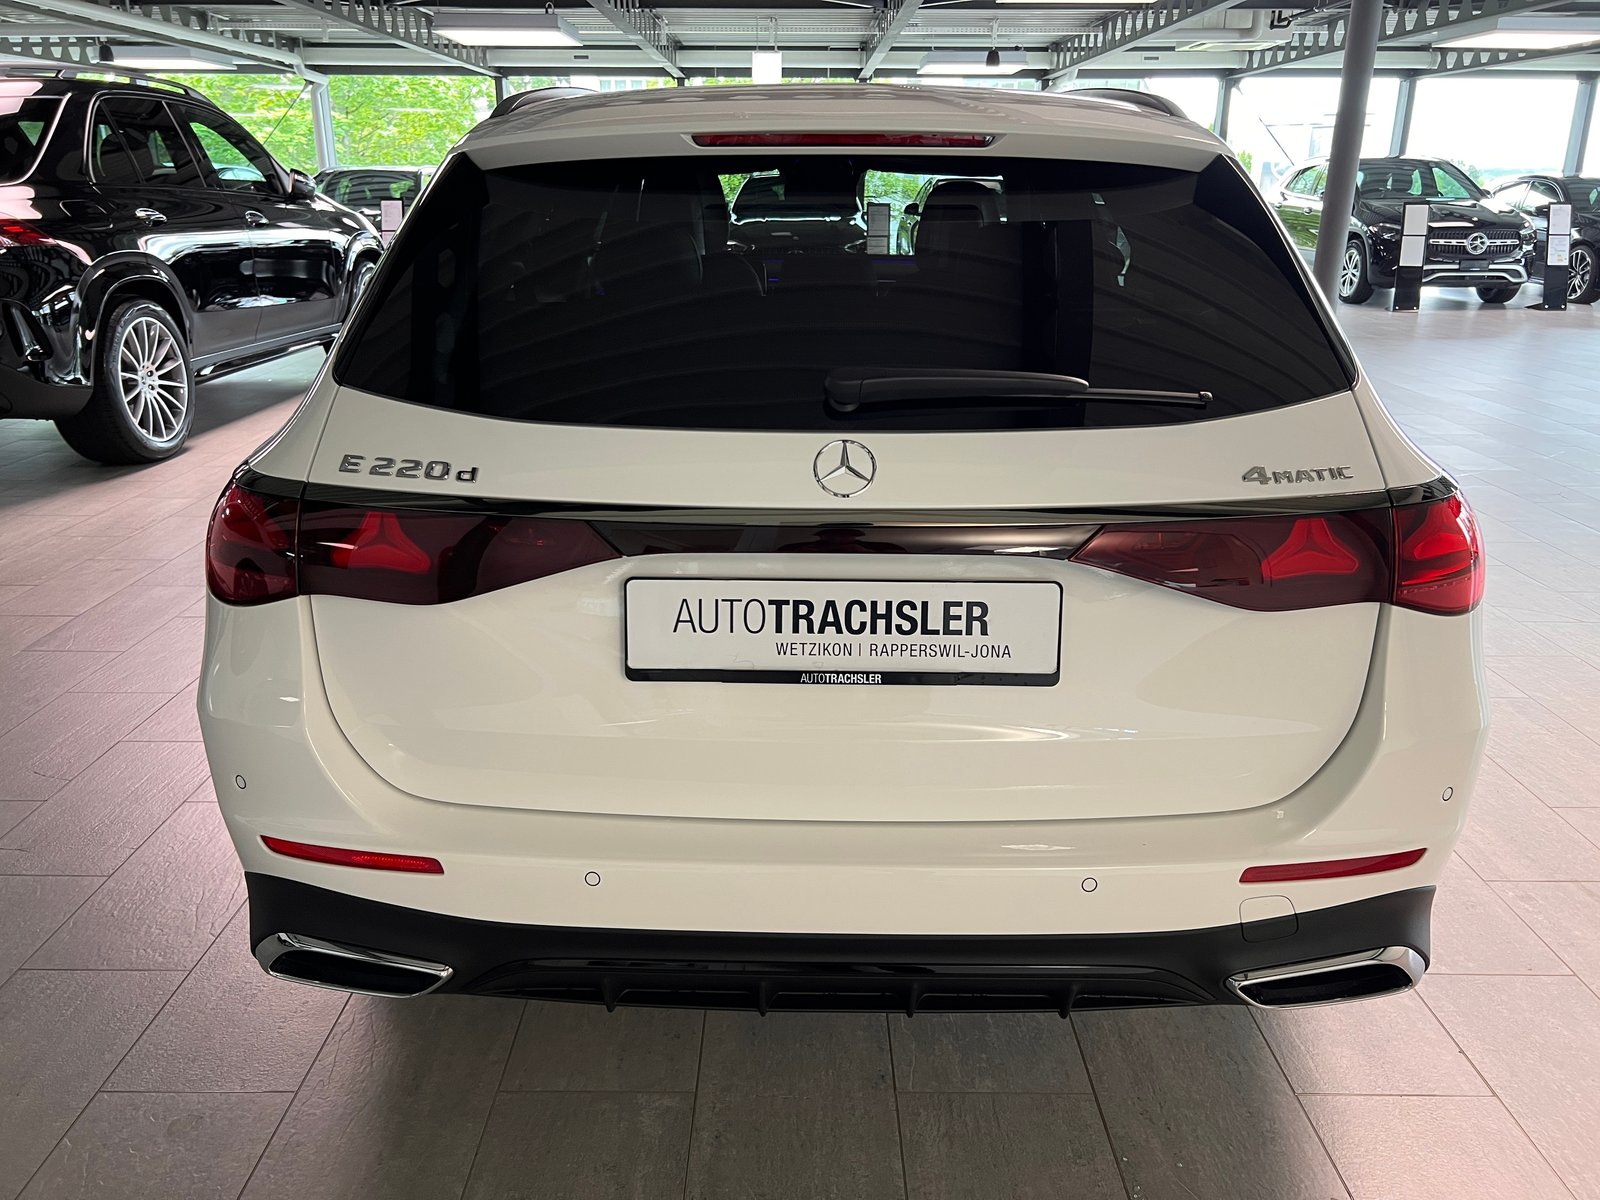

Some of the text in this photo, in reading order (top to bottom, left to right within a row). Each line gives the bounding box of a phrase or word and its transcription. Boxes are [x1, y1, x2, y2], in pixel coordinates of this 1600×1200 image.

[1242, 466, 1354, 485] 4MATIC
[673, 598, 989, 636] AUTOTRACHSLER
[775, 642, 852, 657] WETZIKON
[869, 643, 1012, 659] RAPPERSWIL-JONA
[800, 672, 882, 684] AUTOTRACHSLER
